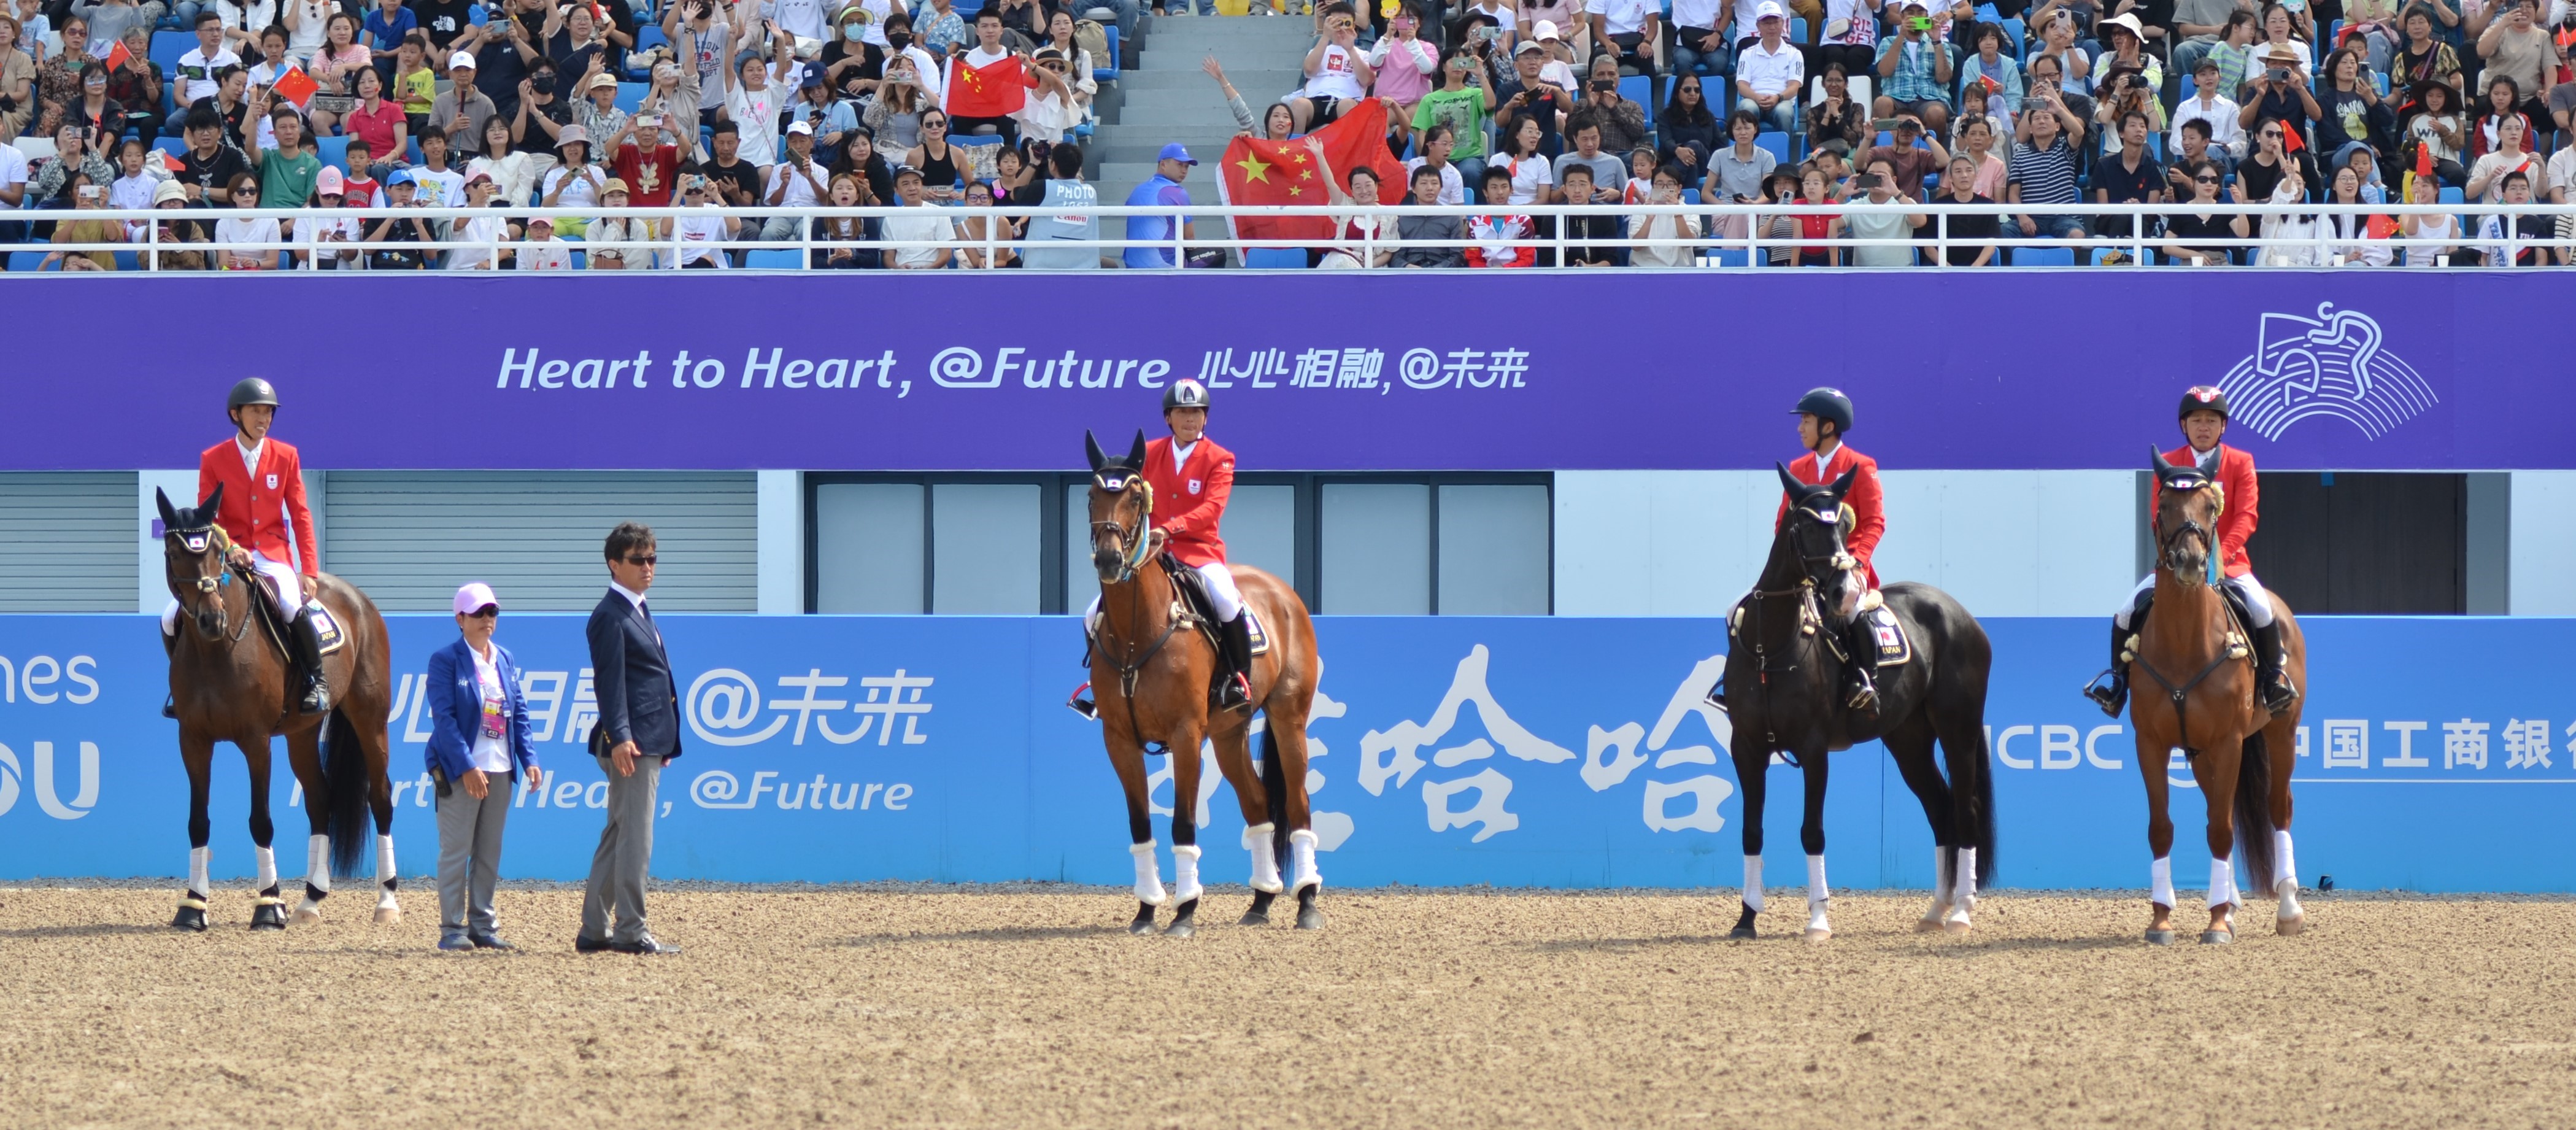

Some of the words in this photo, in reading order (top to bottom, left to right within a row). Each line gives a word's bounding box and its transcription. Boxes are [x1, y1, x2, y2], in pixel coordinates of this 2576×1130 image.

[1057, 185, 1094, 199] PHOTO
[497, 348, 652, 389] Heart
[673, 350, 725, 389] to
[741, 348, 911, 398] Heart,
[930, 347, 1170, 389] @Future
[2294, 718, 2576, 770] 国工商银
[690, 771, 913, 810] @Future
